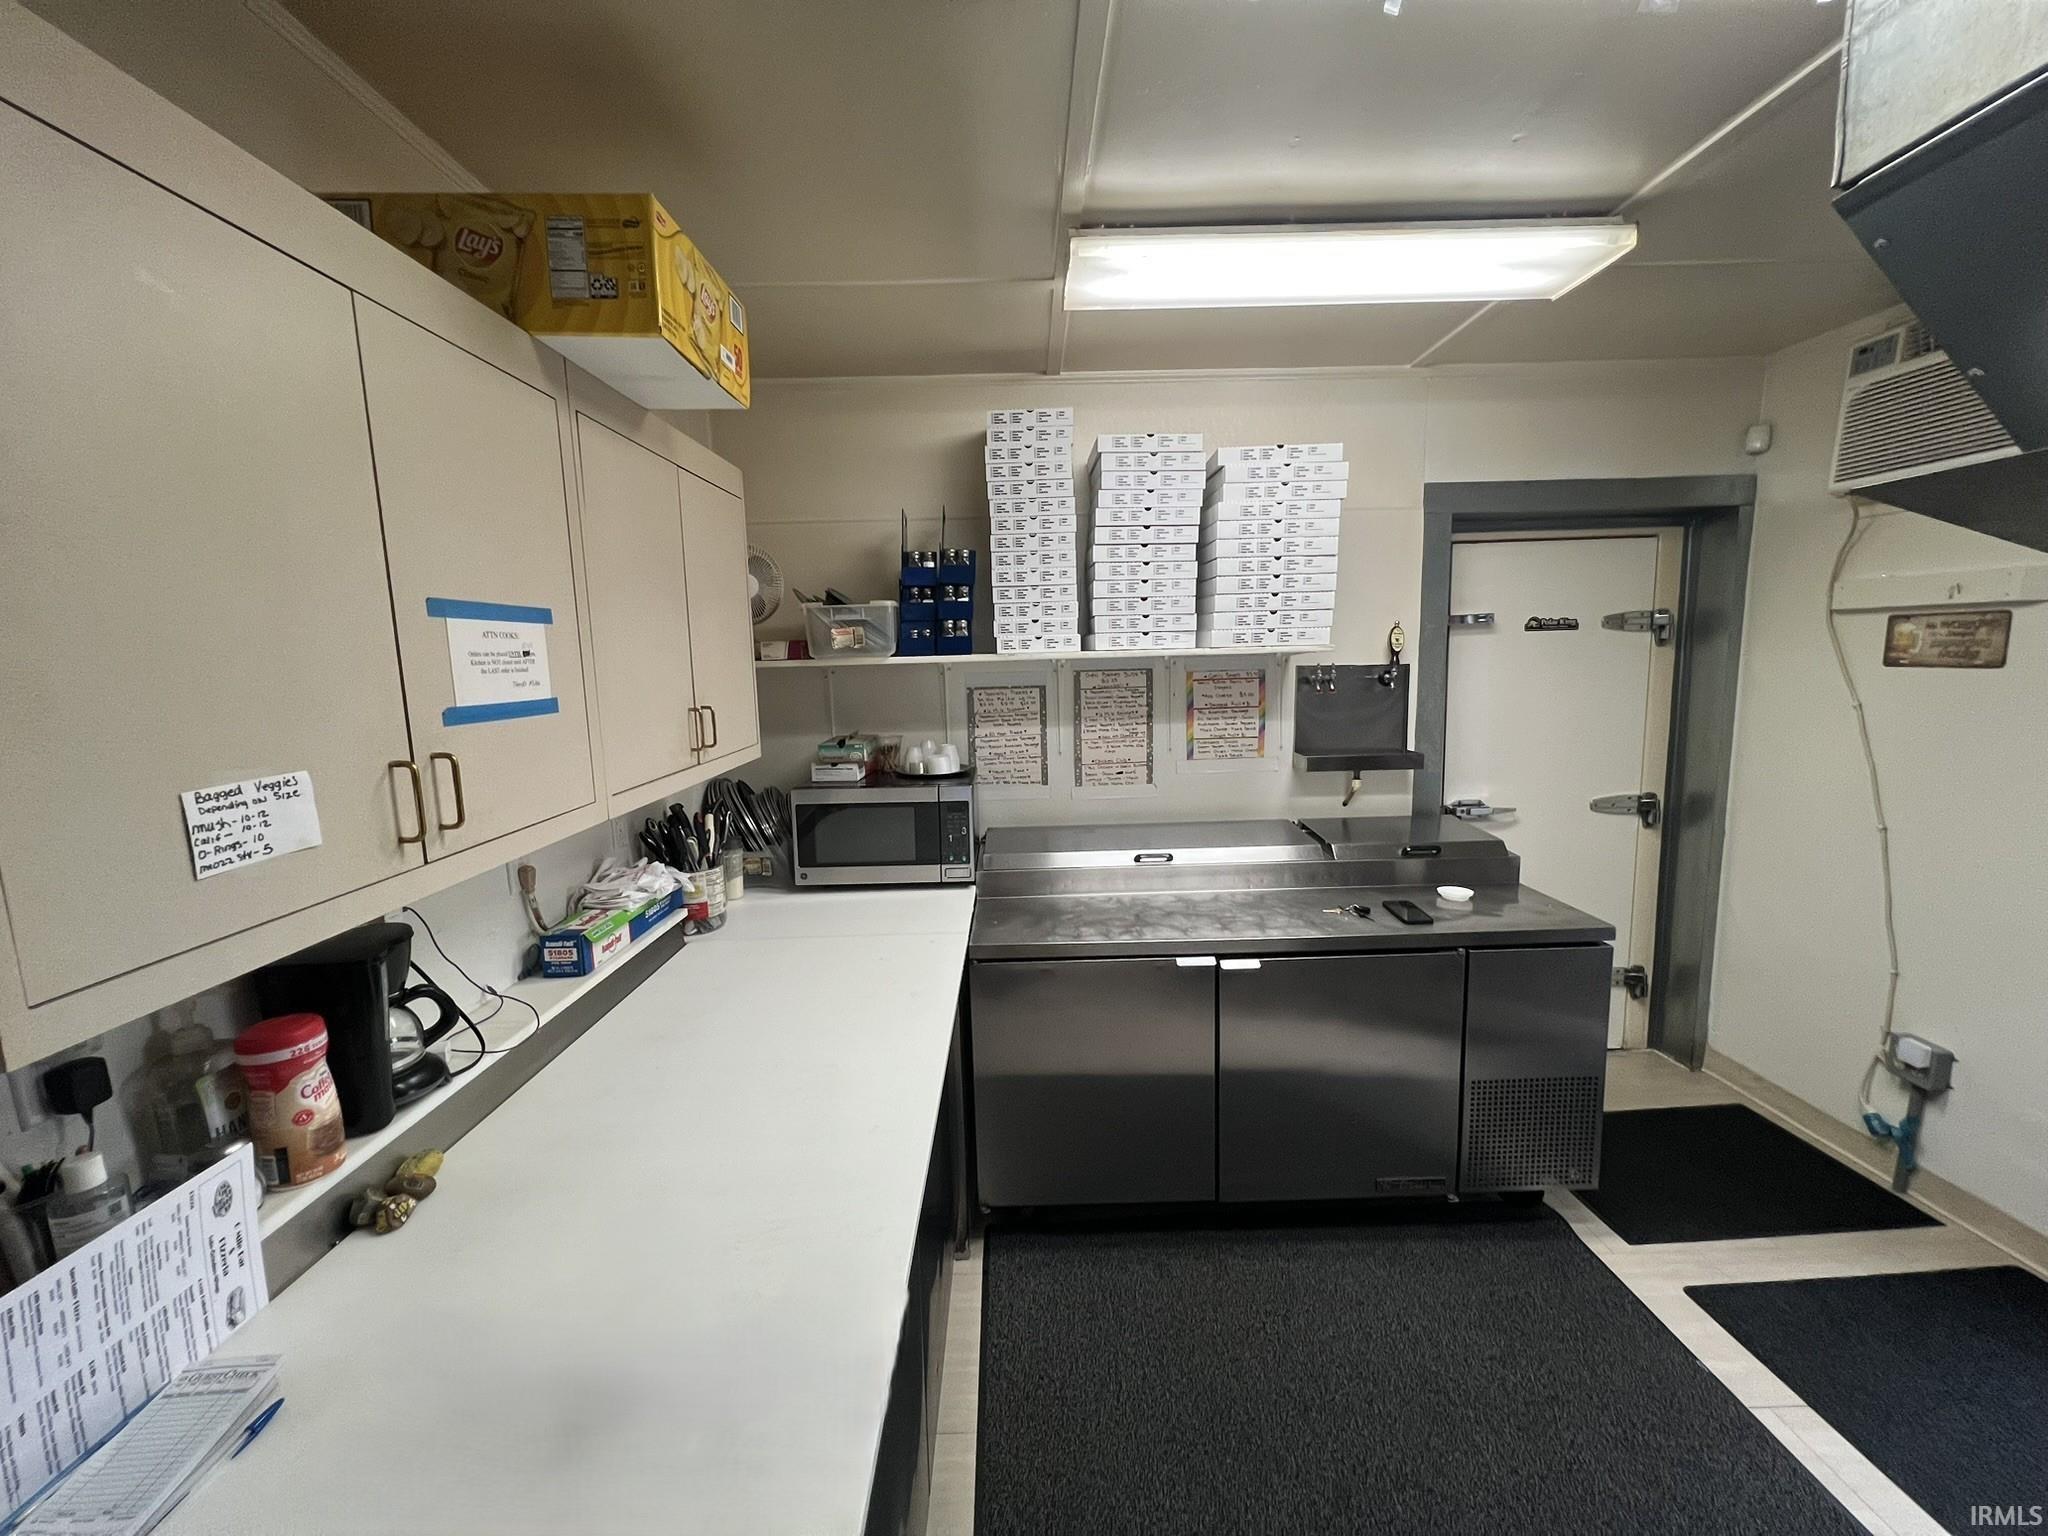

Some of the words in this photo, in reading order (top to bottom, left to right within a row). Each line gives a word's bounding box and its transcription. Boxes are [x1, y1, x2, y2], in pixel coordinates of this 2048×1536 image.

[457, 228, 503, 256] Lay's
[482, 631, 498, 640] ATTN
[194, 784, 243, 805] Bagged
[254, 776, 299, 793] Veggies
[198, 800, 249, 816] Depending
[253, 833, 264, 843] 10
[262, 843, 274, 855] 5
